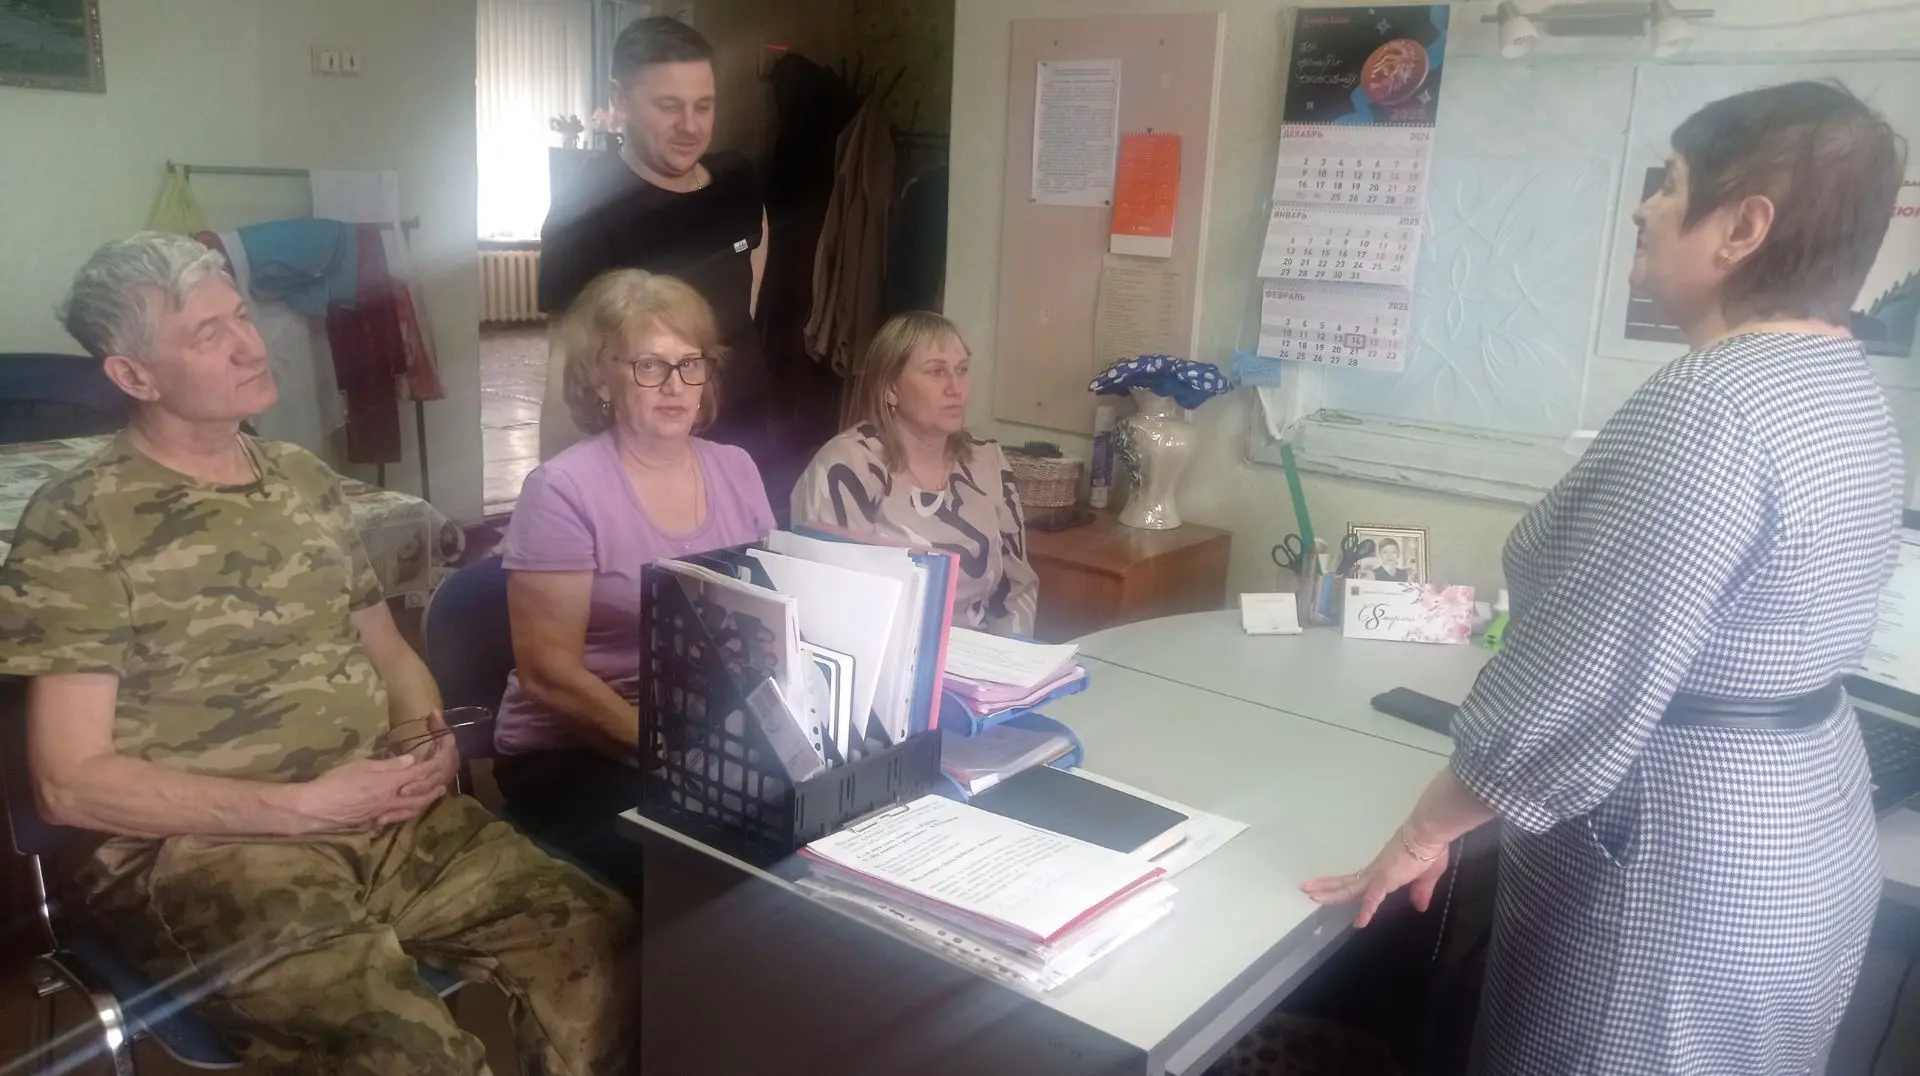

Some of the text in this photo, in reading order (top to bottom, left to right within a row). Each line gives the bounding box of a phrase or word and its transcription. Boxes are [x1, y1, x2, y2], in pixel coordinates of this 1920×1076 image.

[1283, 130, 1323, 138] ДЕКАБРЬ
[1266, 292, 1305, 300] ФЕВРАЛЬ
[1388, 302, 1408, 310] 2025
[1365, 602, 1389, 630] 8
